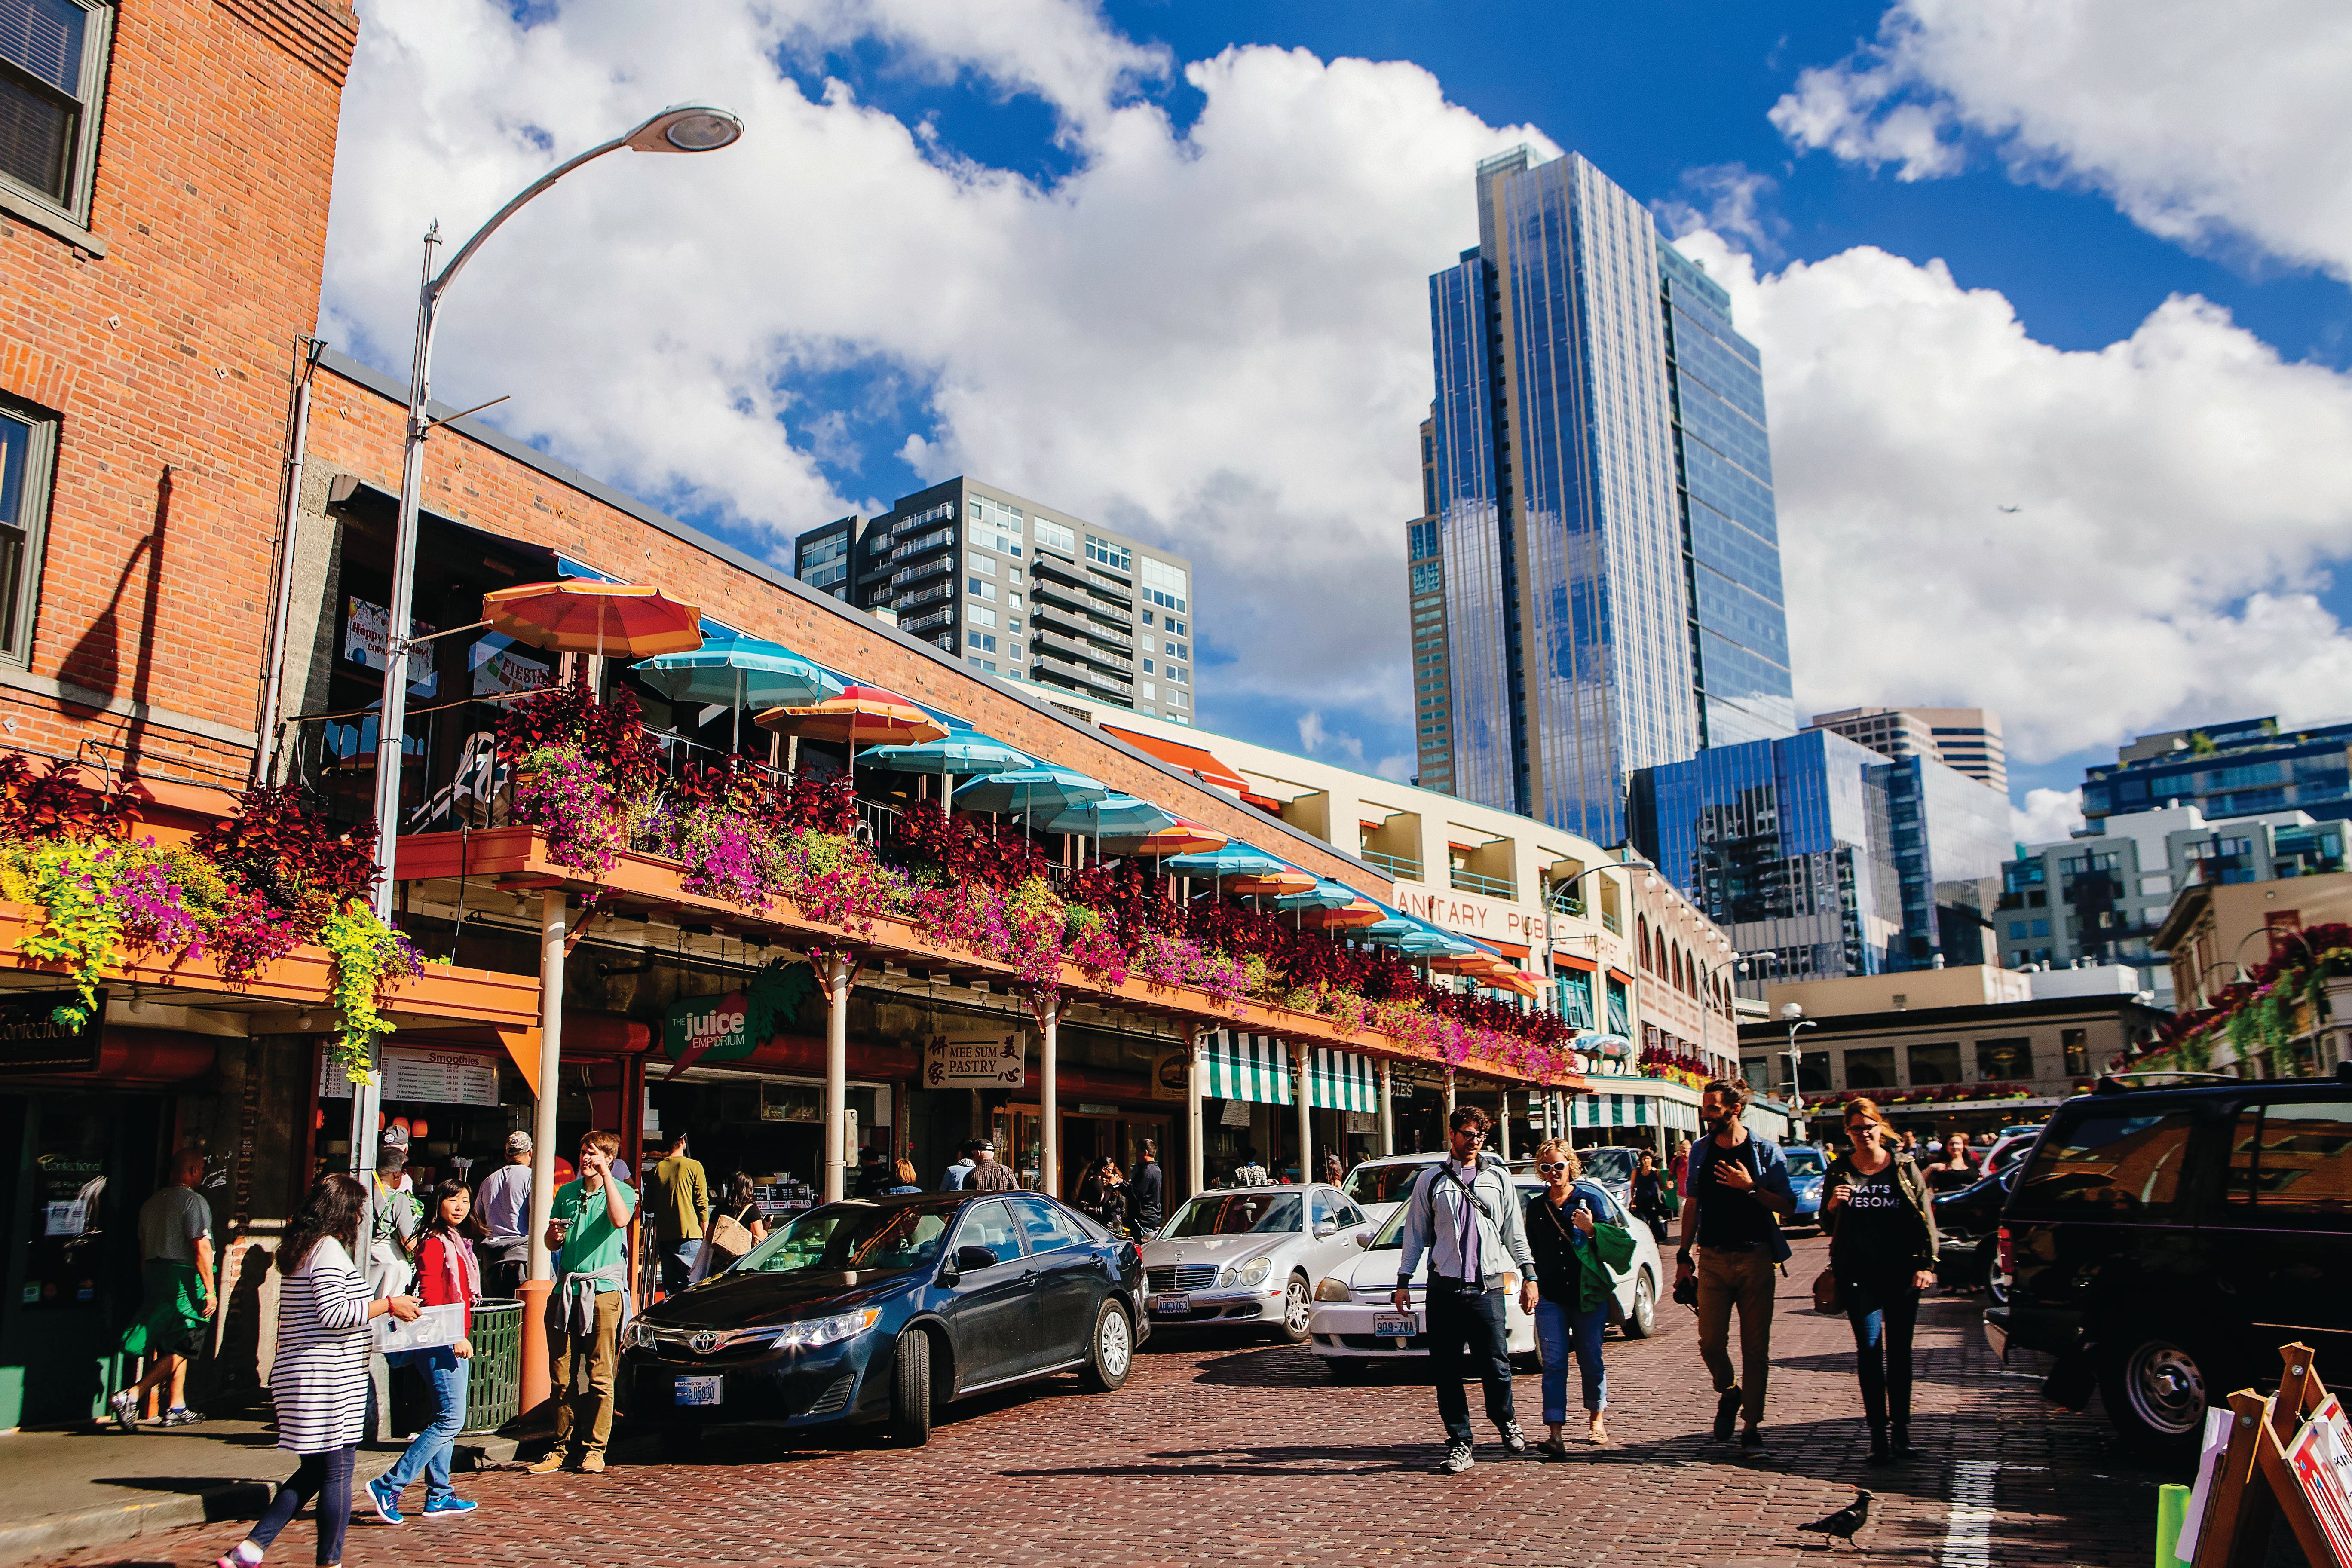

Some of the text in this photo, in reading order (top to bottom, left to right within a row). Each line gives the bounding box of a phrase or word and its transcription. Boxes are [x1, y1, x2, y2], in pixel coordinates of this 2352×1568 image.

[352, 622, 383, 644] Happy
[1399, 891, 1487, 928] ANITARY
[684, 1010, 745, 1041] juice
[692, 1034, 744, 1048] EMPORIUM
[429, 1052, 479, 1066] Smoothies
[949, 1047, 997, 1058] MEE SUM
[949, 1060, 997, 1072] PASTRY
[1377, 1321, 1414, 1333] 909-ZVA
[693, 1386, 714, 1400] 05830
